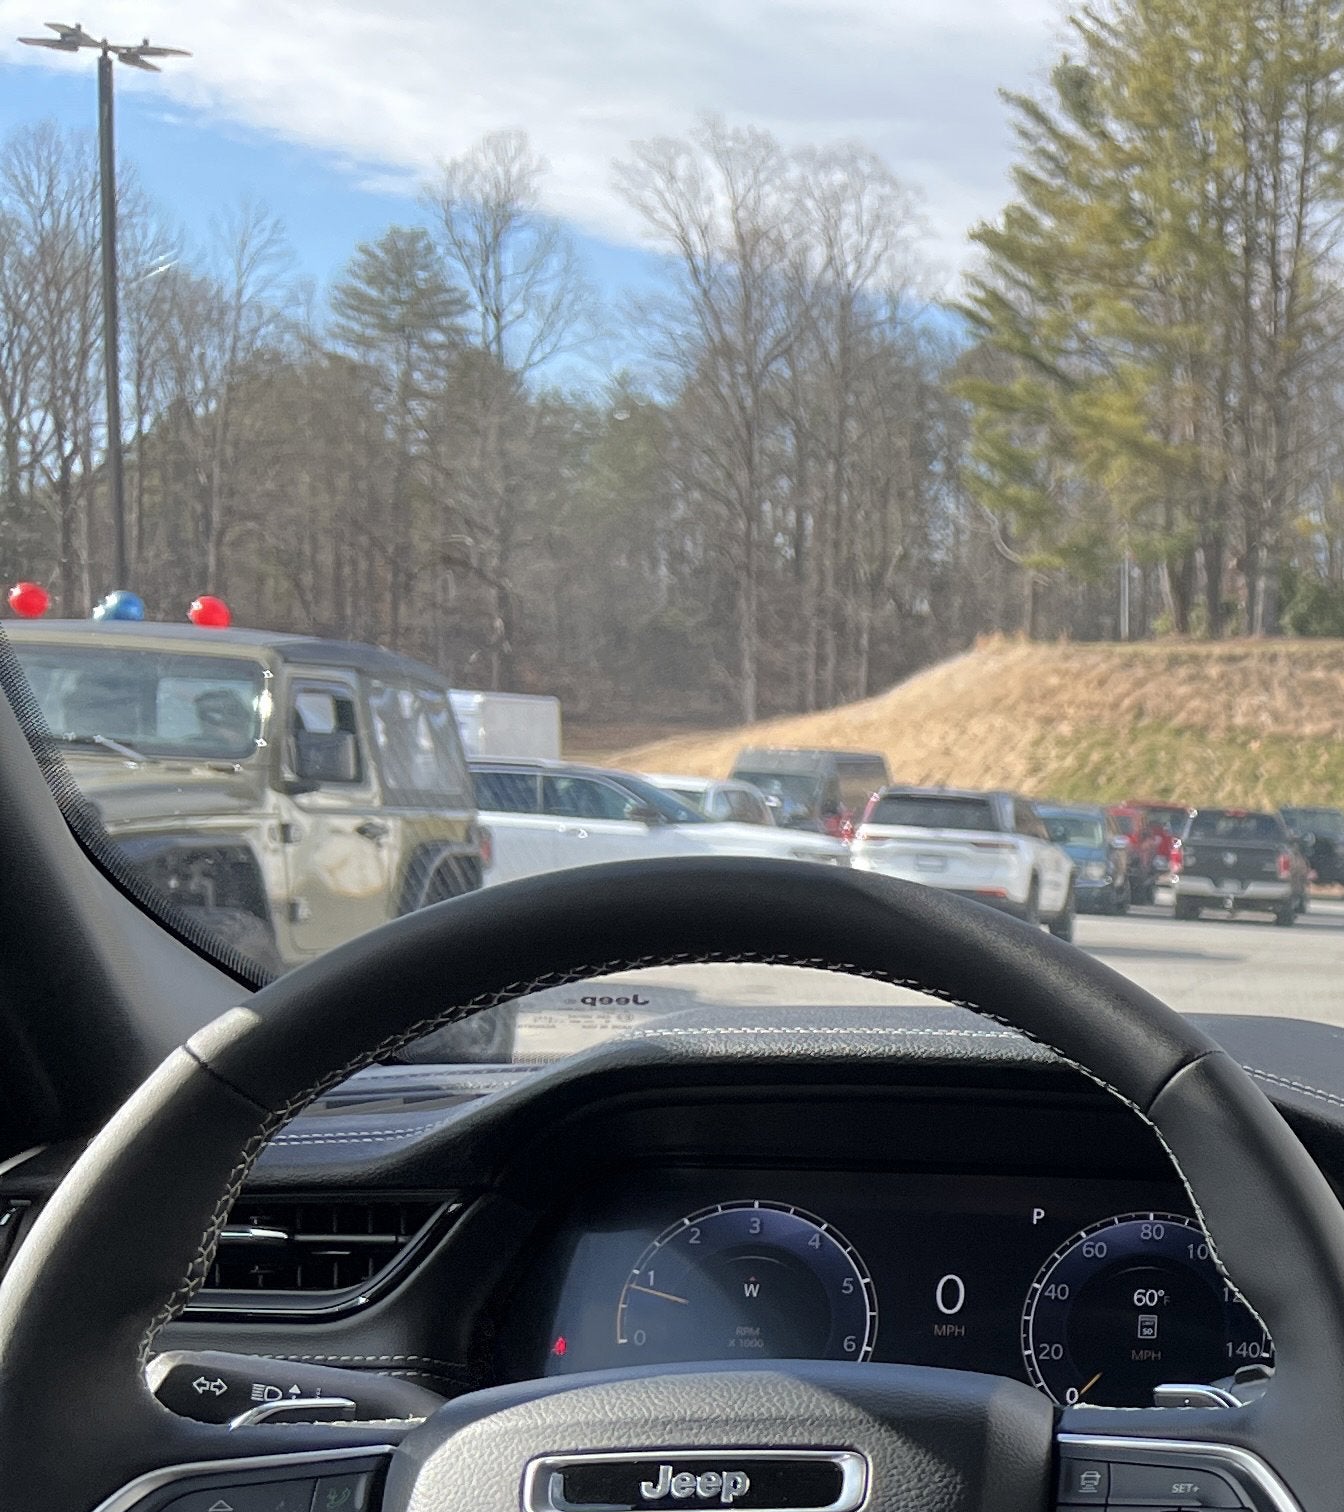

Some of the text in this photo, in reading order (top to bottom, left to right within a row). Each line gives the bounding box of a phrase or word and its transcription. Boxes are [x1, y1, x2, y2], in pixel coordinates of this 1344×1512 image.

[1033, 1208, 1045, 1225] P
[749, 1217, 761, 1234] 3
[1140, 1224, 1165, 1240] 80
[688, 1228, 701, 1244] 2
[807, 1233, 821, 1249] 4
[1082, 1241, 1107, 1258] 60
[743, 1283, 760, 1298] W
[841, 1277, 854, 1294] 5
[1044, 1284, 1069, 1300] 40
[935, 1274, 965, 1315] 0
[633, 1329, 646, 1346] 0
[735, 1326, 761, 1336] RPM
[933, 1324, 966, 1337] MPH
[843, 1335, 856, 1352] 6
[1038, 1343, 1064, 1360] 20
[1226, 1341, 1261, 1359] 140
[1131, 1349, 1162, 1361] MPH
[1065, 1387, 1079, 1404] 0
[640, 1464, 750, 1504] Jeep
